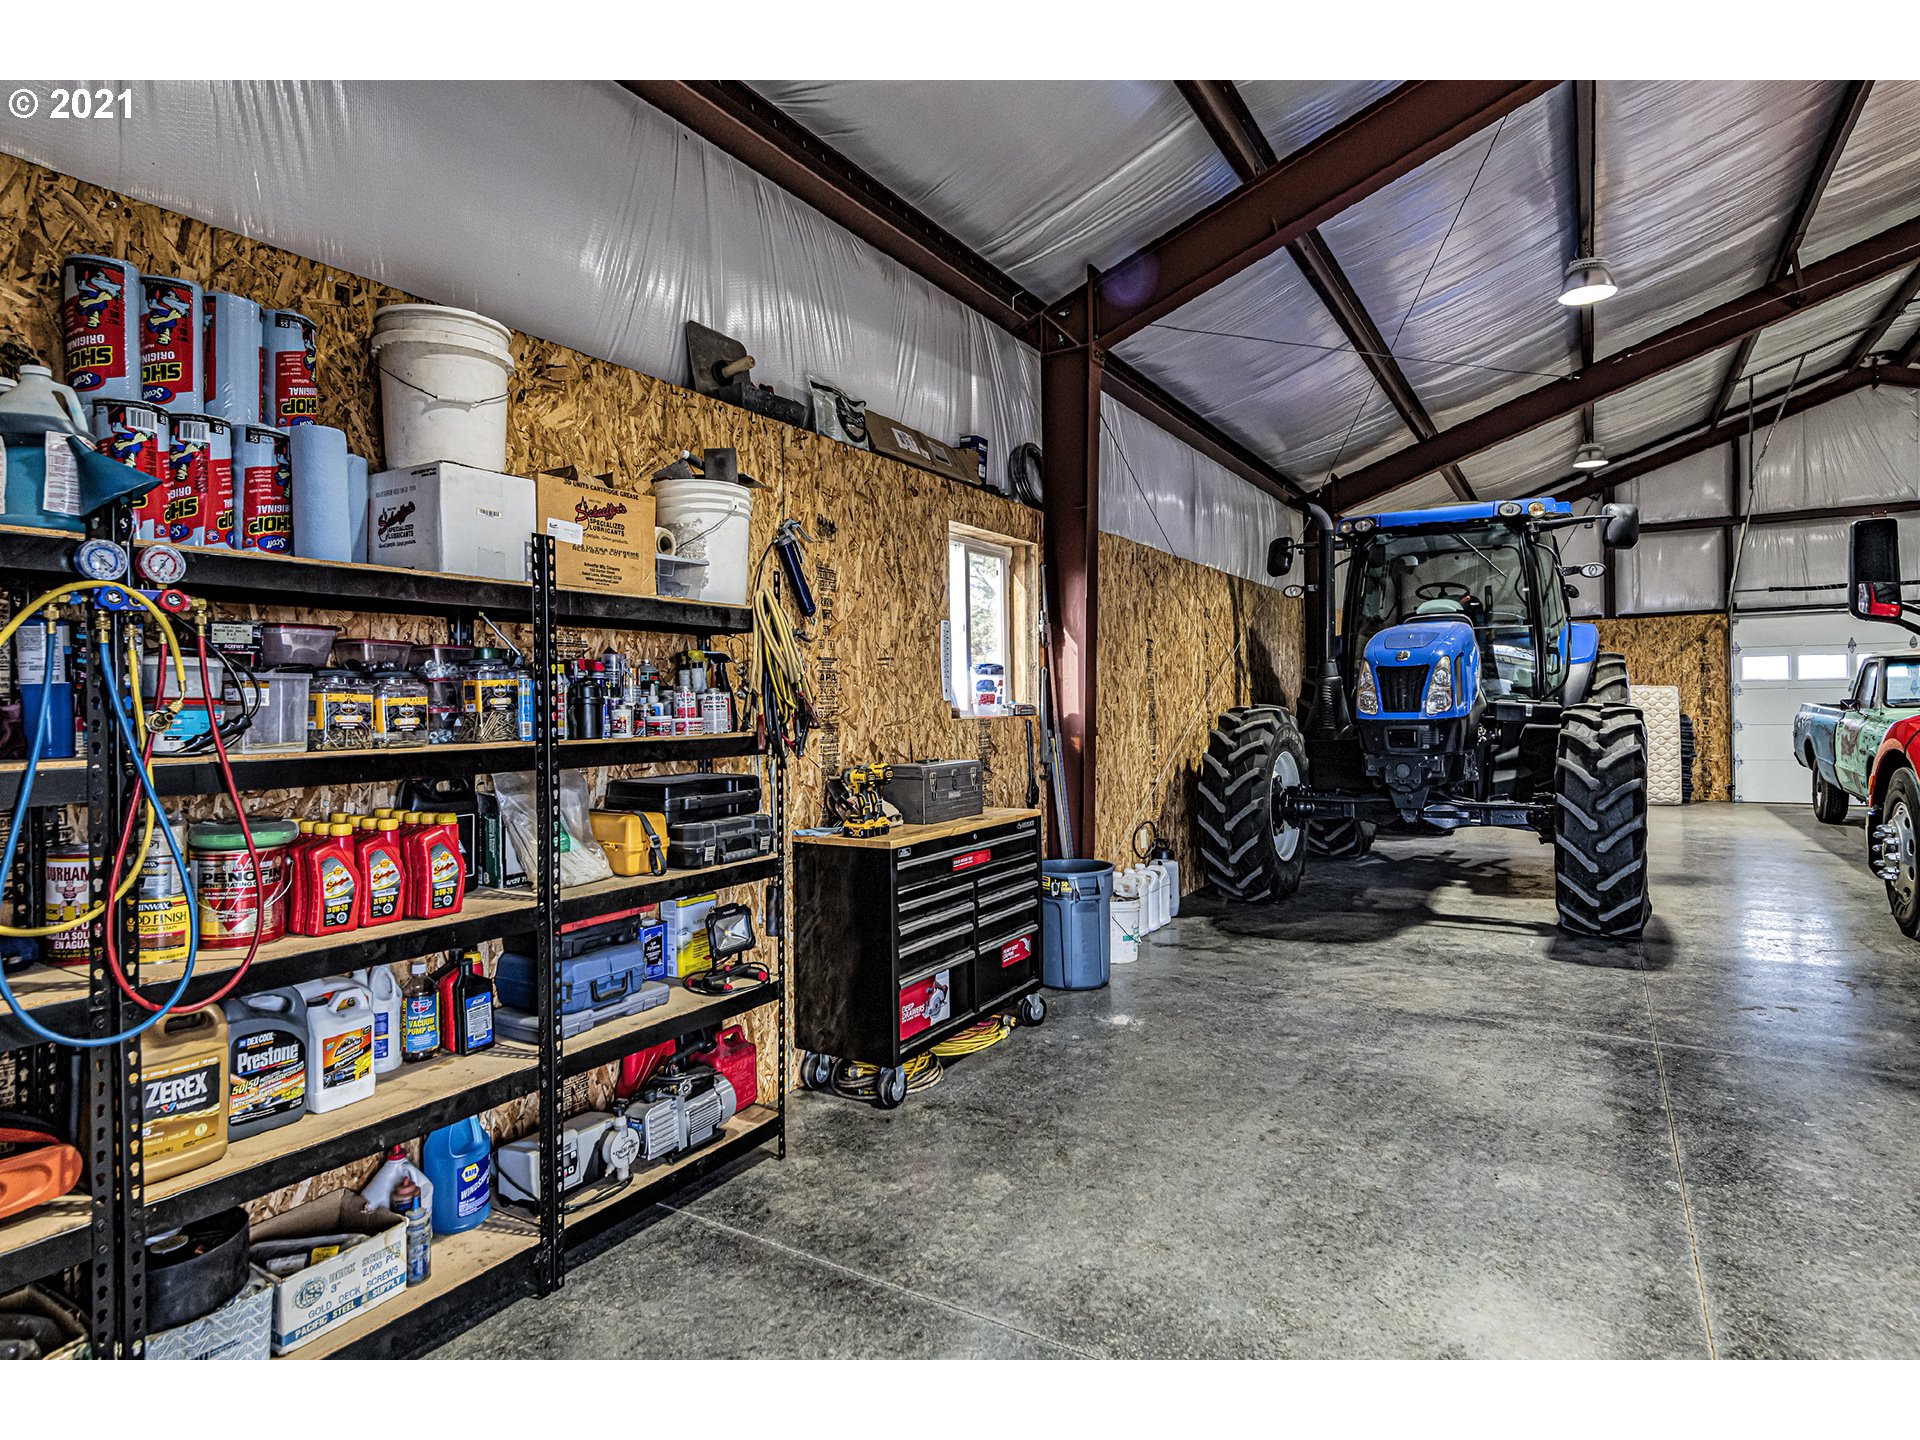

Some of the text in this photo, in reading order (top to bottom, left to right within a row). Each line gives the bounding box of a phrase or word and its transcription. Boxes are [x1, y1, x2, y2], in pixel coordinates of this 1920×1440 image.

[143, 362, 182, 384] SHO
[281, 398, 316, 414] HOP
[215, 426, 222, 434] 55
[573, 481, 588, 490] UNITS
[590, 486, 618, 496] CARTRIDGE
[620, 490, 639, 500] GREASE
[590, 518, 625, 530] SPECIALIZED
[589, 526, 625, 537] LUBRICANTS
[266, 537, 287, 550] Scott
[138, 900, 172, 912] INWAX
[154, 912, 186, 924] FINISH
[54, 940, 90, 949] EN AGUA
[902, 1002, 914, 1014] DEEP
[902, 1004, 925, 1020] DRAWERS
[408, 1017, 434, 1028] VACUUM
[408, 1027, 426, 1035] PUMP
[237, 1044, 298, 1074] Prestone
[334, 1048, 364, 1069] Protectant
[145, 1071, 208, 1109] ZEREX
[232, 1076, 260, 1096] 50/50
[176, 1096, 206, 1110] Valvoline
[464, 1168, 478, 1178] NAPA
[362, 1250, 401, 1277] 2,000 PCS
[308, 1301, 332, 1320] GOLD
[338, 1286, 361, 1304] DECK
[366, 1265, 398, 1290] SCREWS
[295, 1276, 402, 1340] PACIFIC STEEL & SUPPLY
